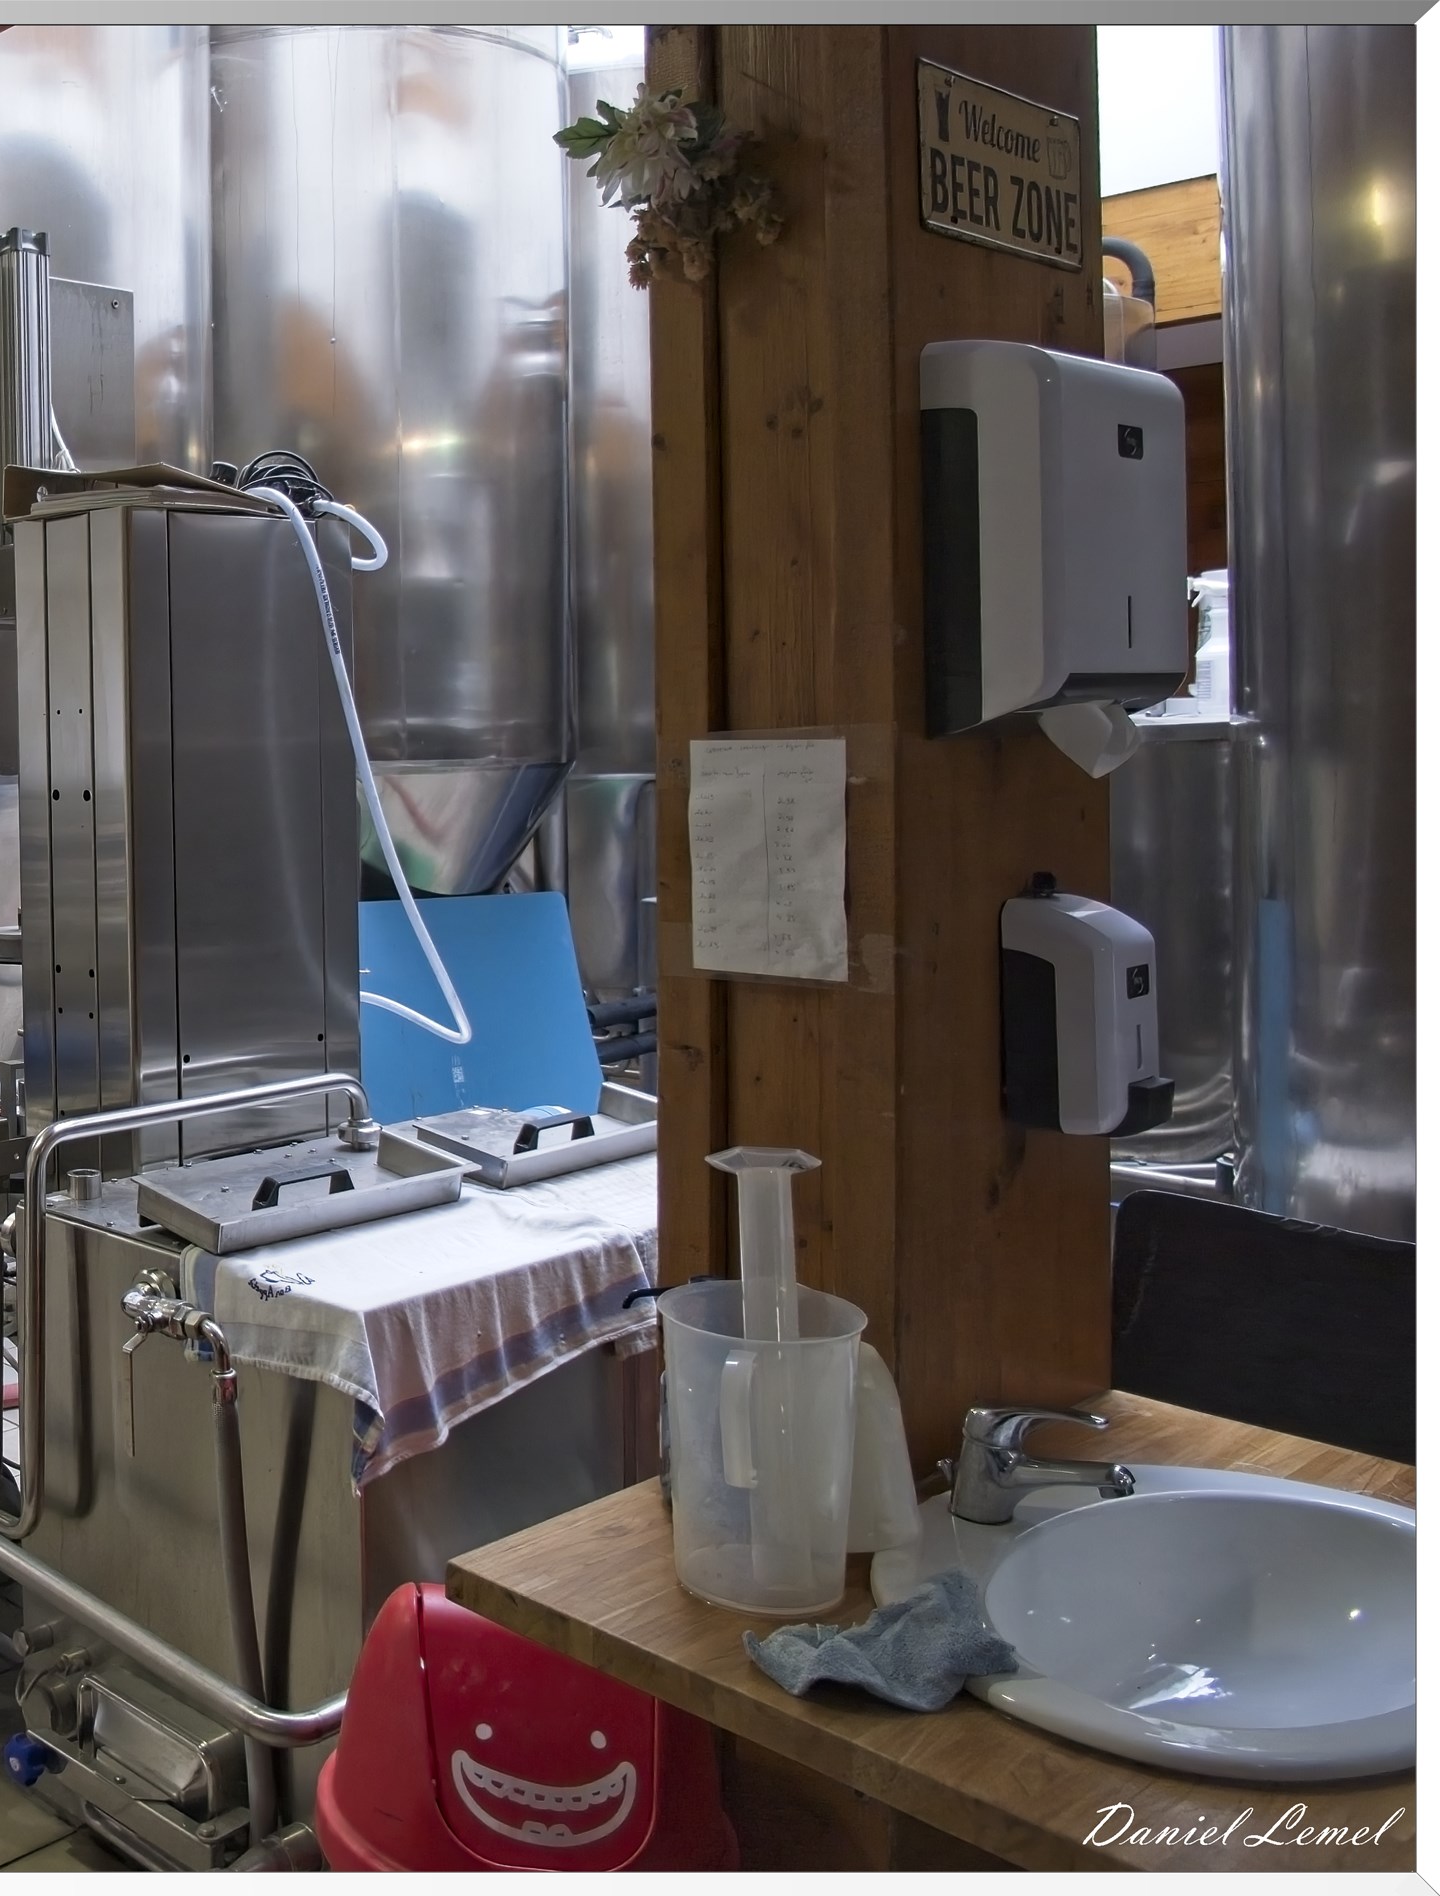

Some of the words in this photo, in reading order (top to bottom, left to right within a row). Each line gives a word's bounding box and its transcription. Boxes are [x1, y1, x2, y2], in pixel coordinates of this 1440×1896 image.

[958, 100, 1041, 163] Welcome
[930, 147, 1001, 231] BEER
[1010, 175, 1078, 254] ZONE
